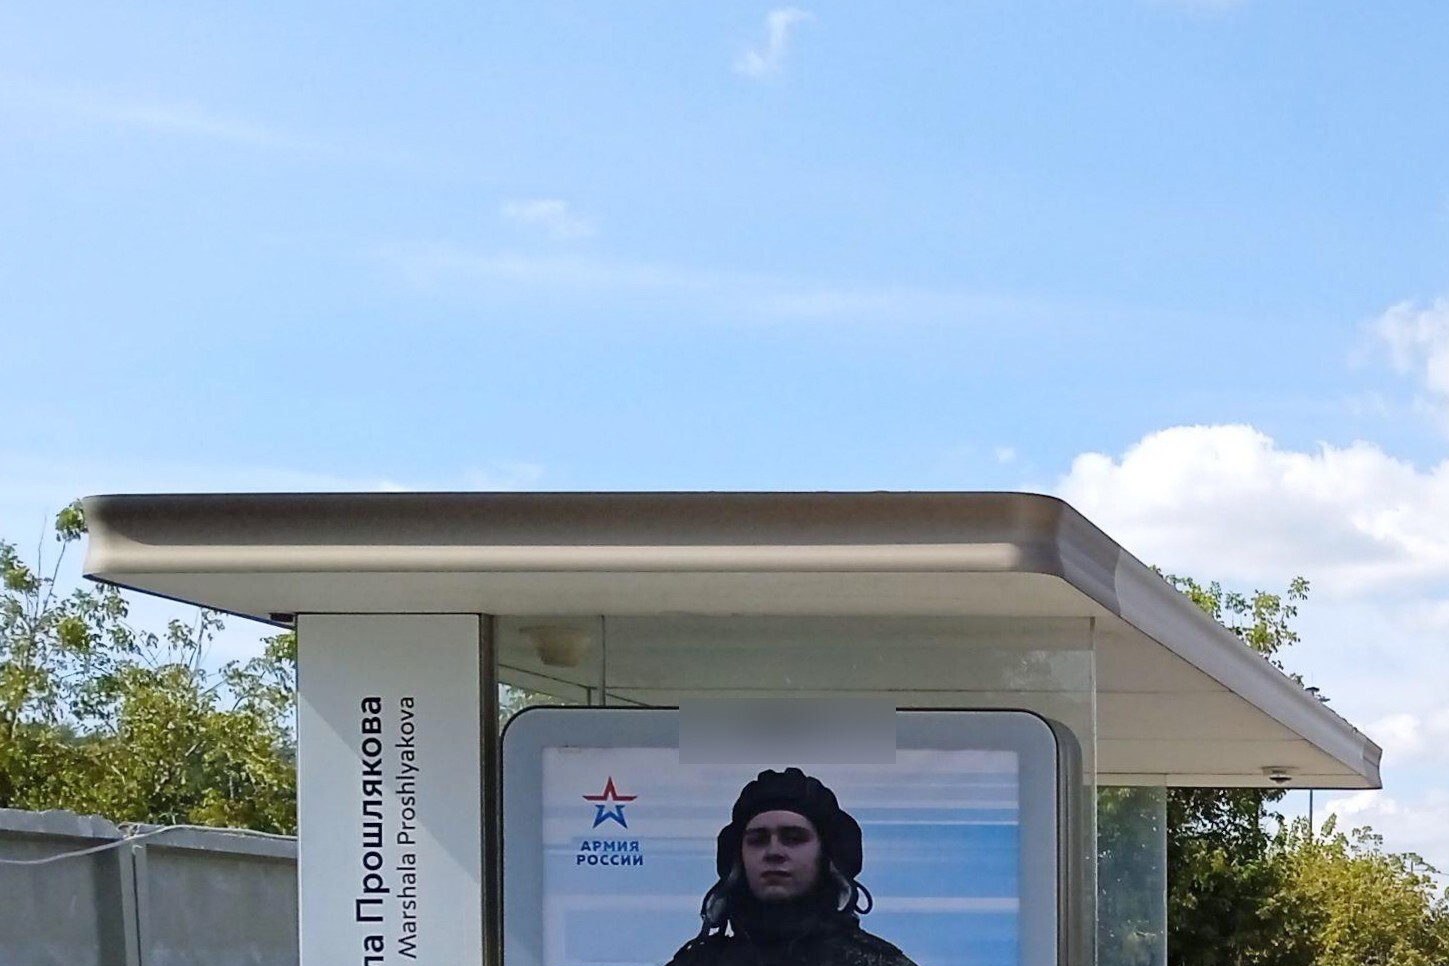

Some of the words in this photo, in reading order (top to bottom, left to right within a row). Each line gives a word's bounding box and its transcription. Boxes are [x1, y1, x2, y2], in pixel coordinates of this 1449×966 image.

[355, 696, 390, 924] Прошлякова
[396, 696, 420, 845] Proshlyakova
[576, 854, 644, 866] РОССИИ
[580, 840, 640, 852] АРМИЯ
[396, 853, 417, 959] Marshala
